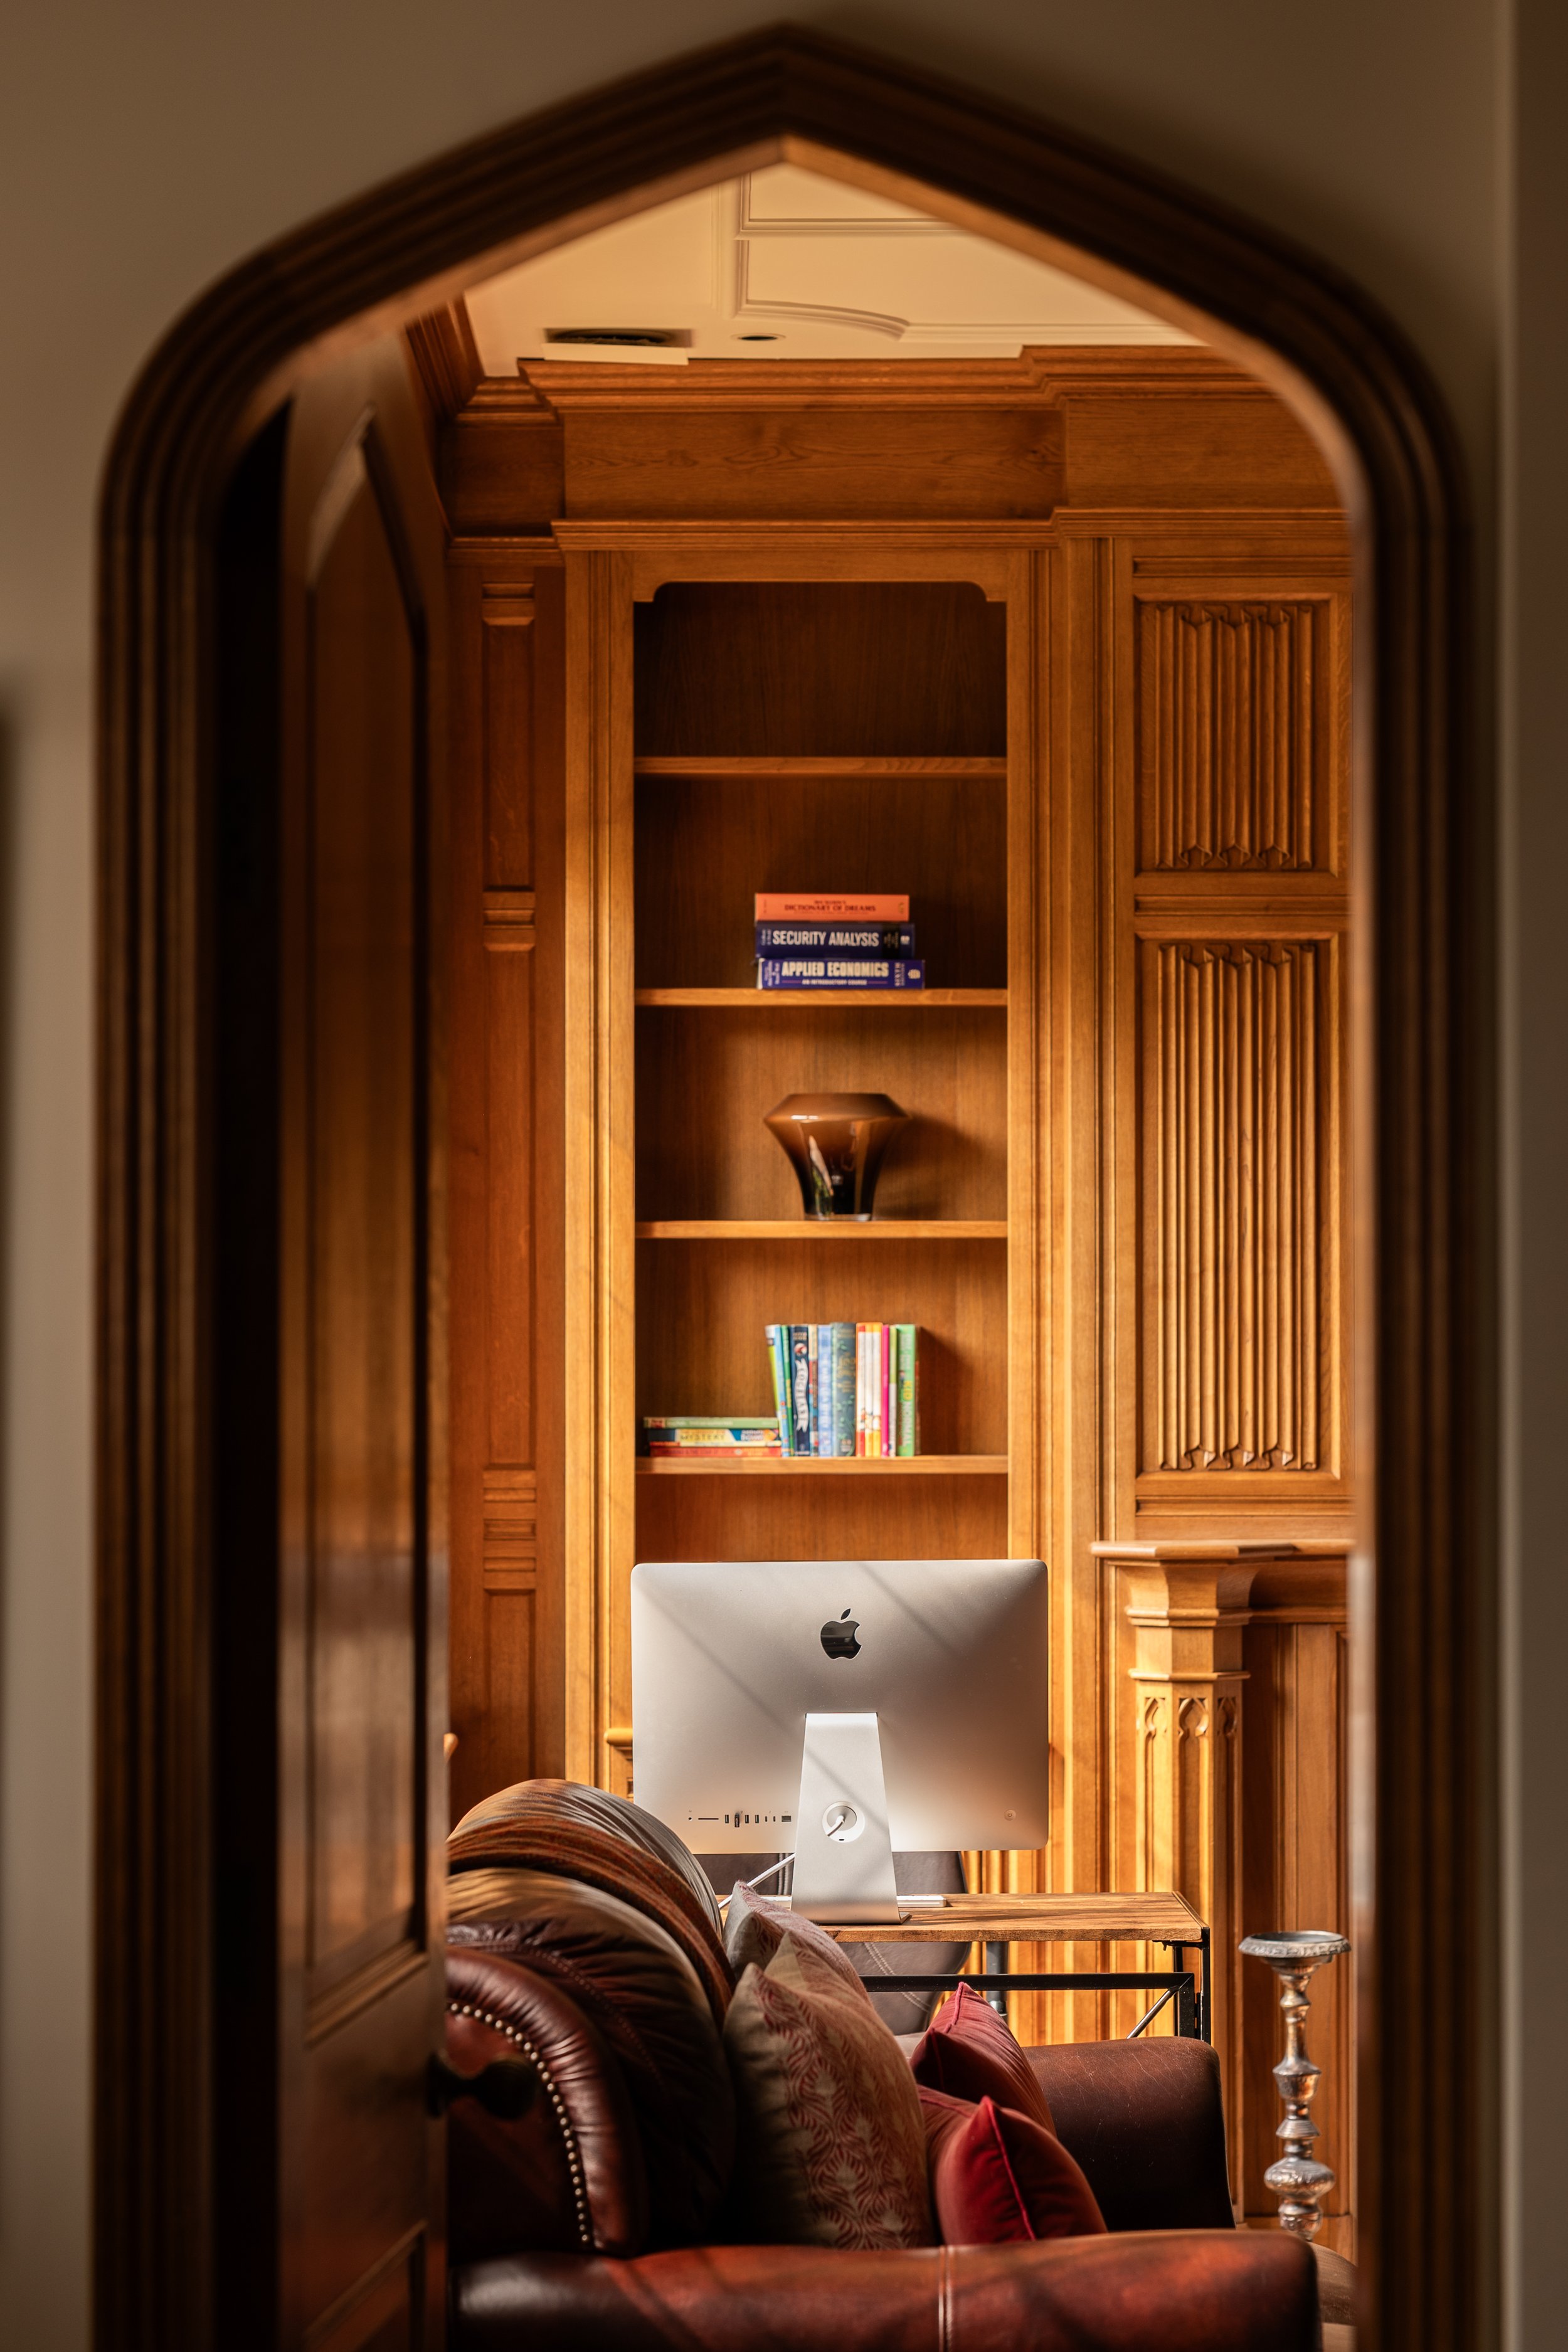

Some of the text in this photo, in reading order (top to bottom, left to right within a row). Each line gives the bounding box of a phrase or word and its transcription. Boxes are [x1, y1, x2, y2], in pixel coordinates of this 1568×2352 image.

[772, 930, 827, 945] SECURITY
[829, 931, 879, 946] ANALYSIS
[781, 961, 824, 977] APPLIED
[827, 961, 889, 977] ECONOMICS
[903, 1380, 913, 1400] KID
[903, 1402, 913, 1446] NORMAL
